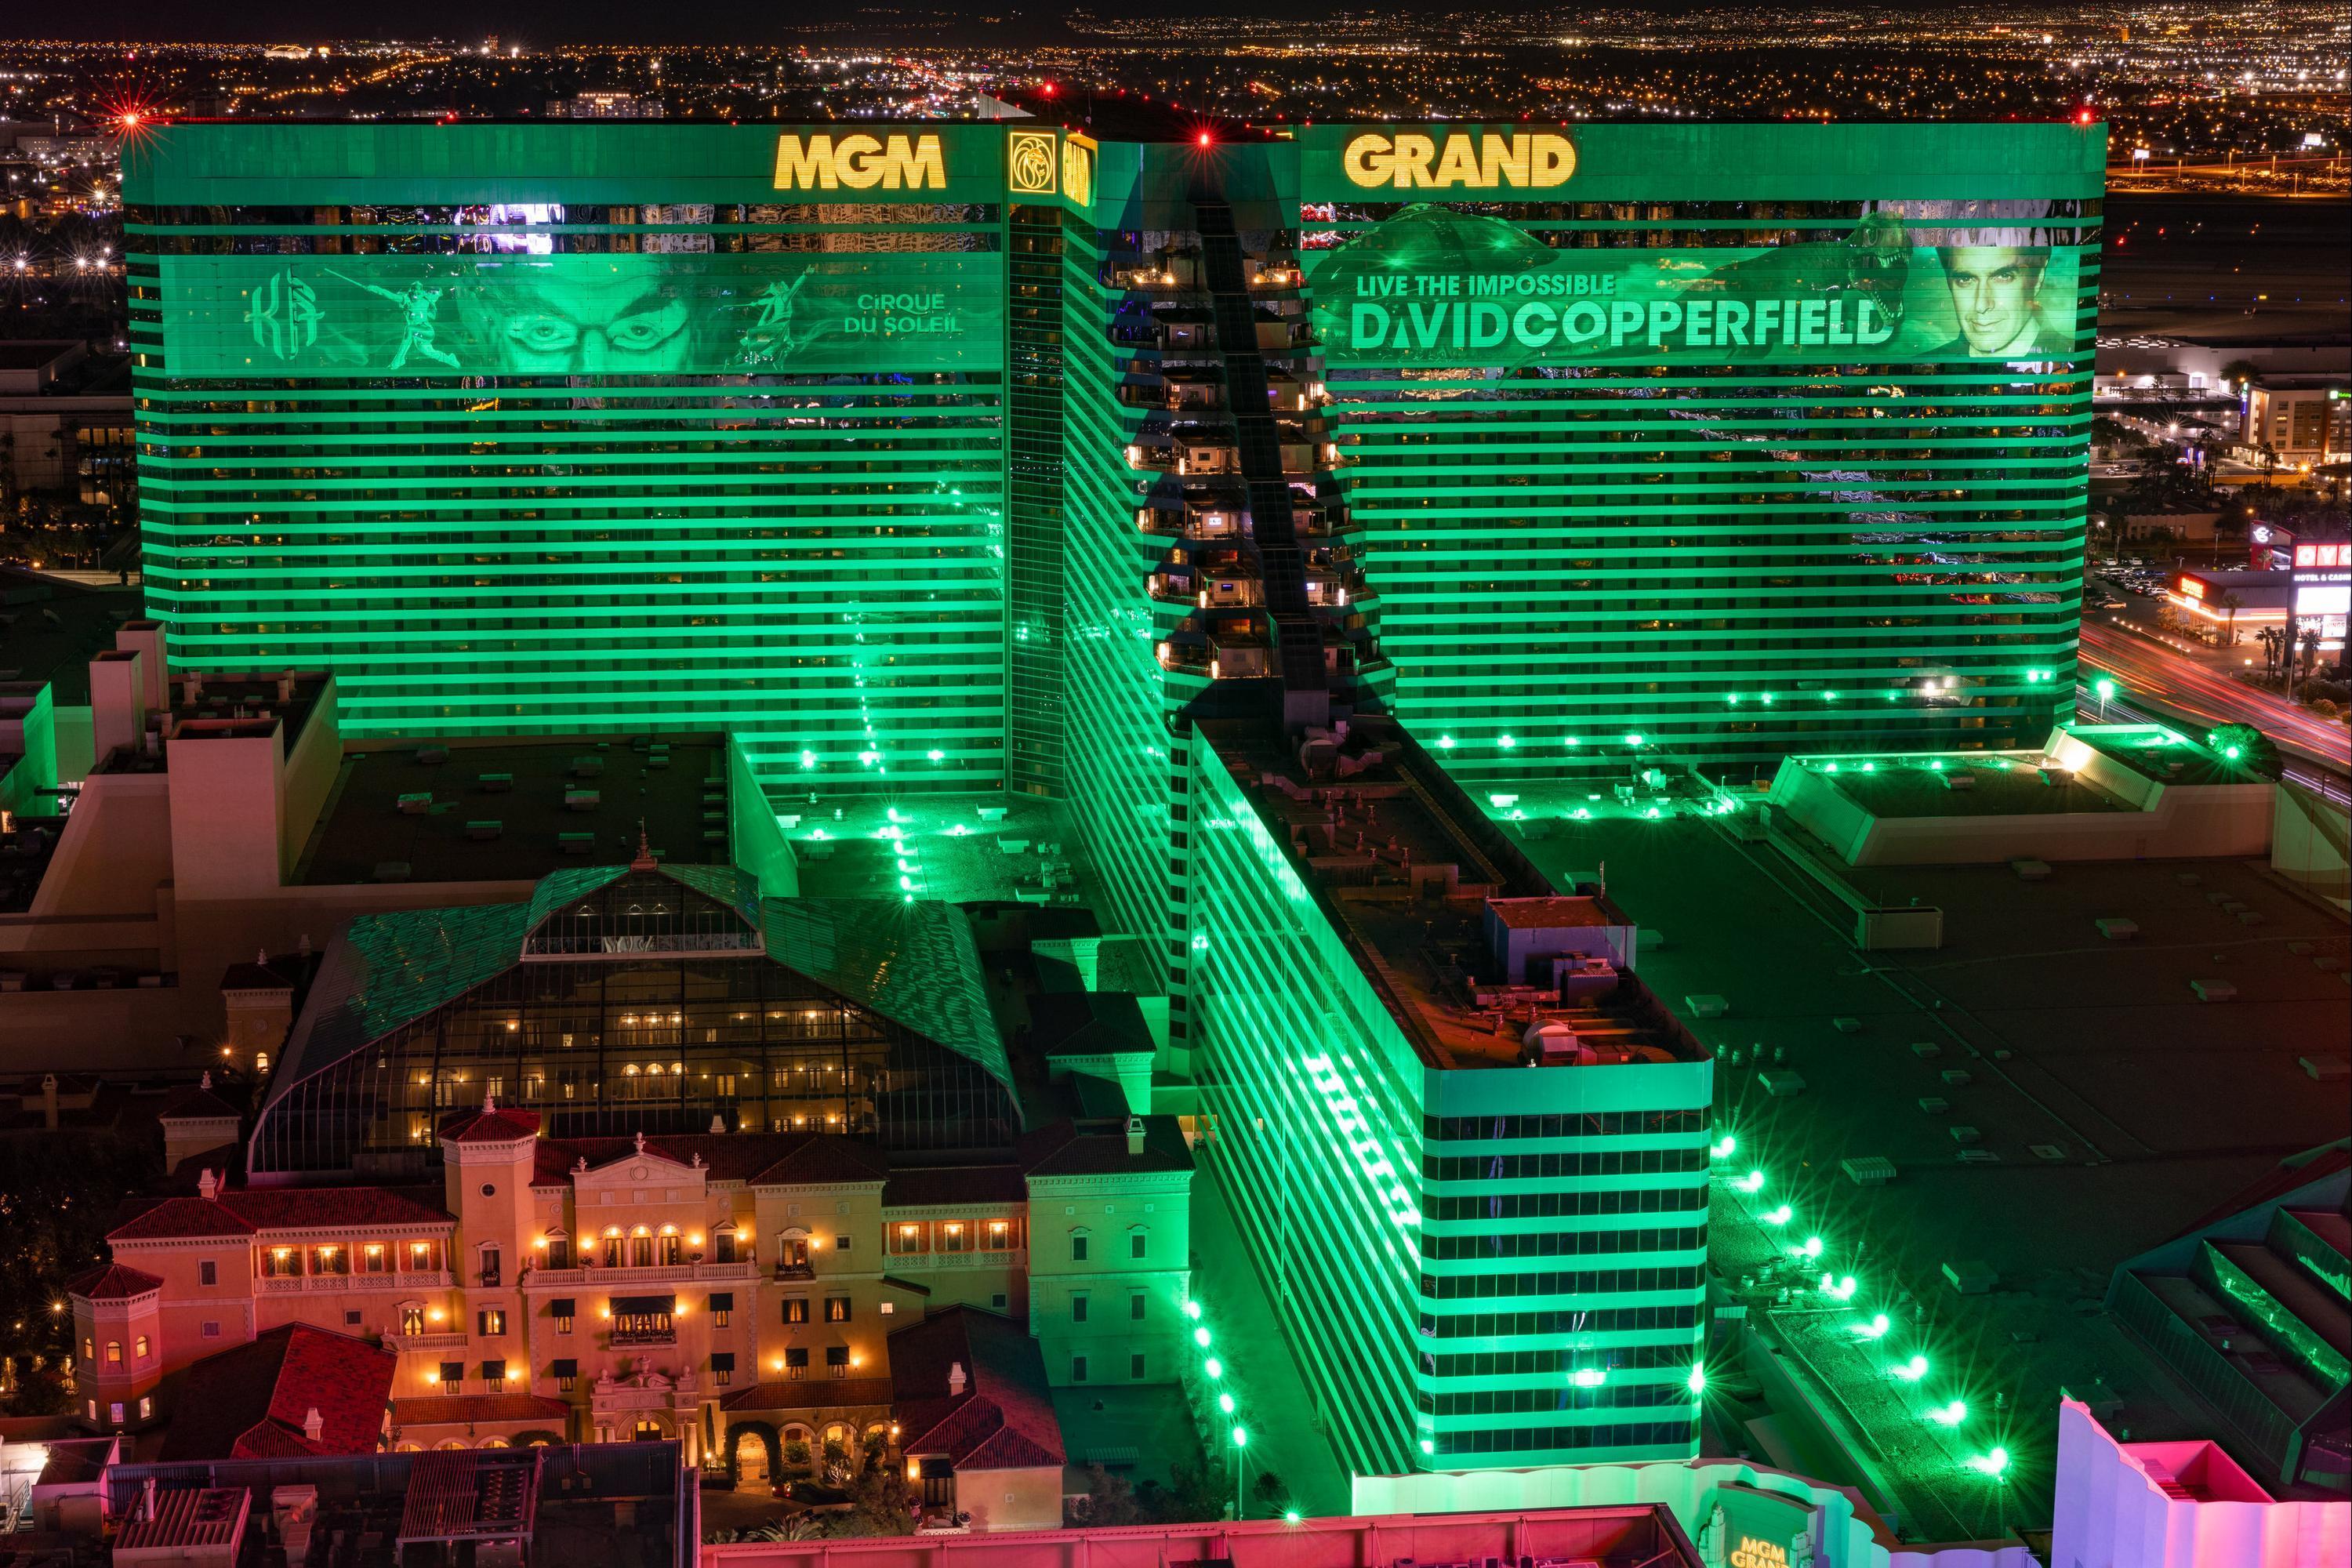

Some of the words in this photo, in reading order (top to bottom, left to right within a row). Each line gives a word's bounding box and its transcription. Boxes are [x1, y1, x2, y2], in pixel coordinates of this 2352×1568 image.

[773, 135, 946, 189] MGM
[1344, 134, 1577, 187] GRAND
[1357, 275, 1408, 296] LIVE
[1415, 275, 1460, 296] THE
[1468, 274, 1615, 296] IMPOSSIBLE
[844, 317, 877, 333] DU
[884, 317, 964, 333] SOLEIL
[1740, 1536, 1785, 1563] MGM
